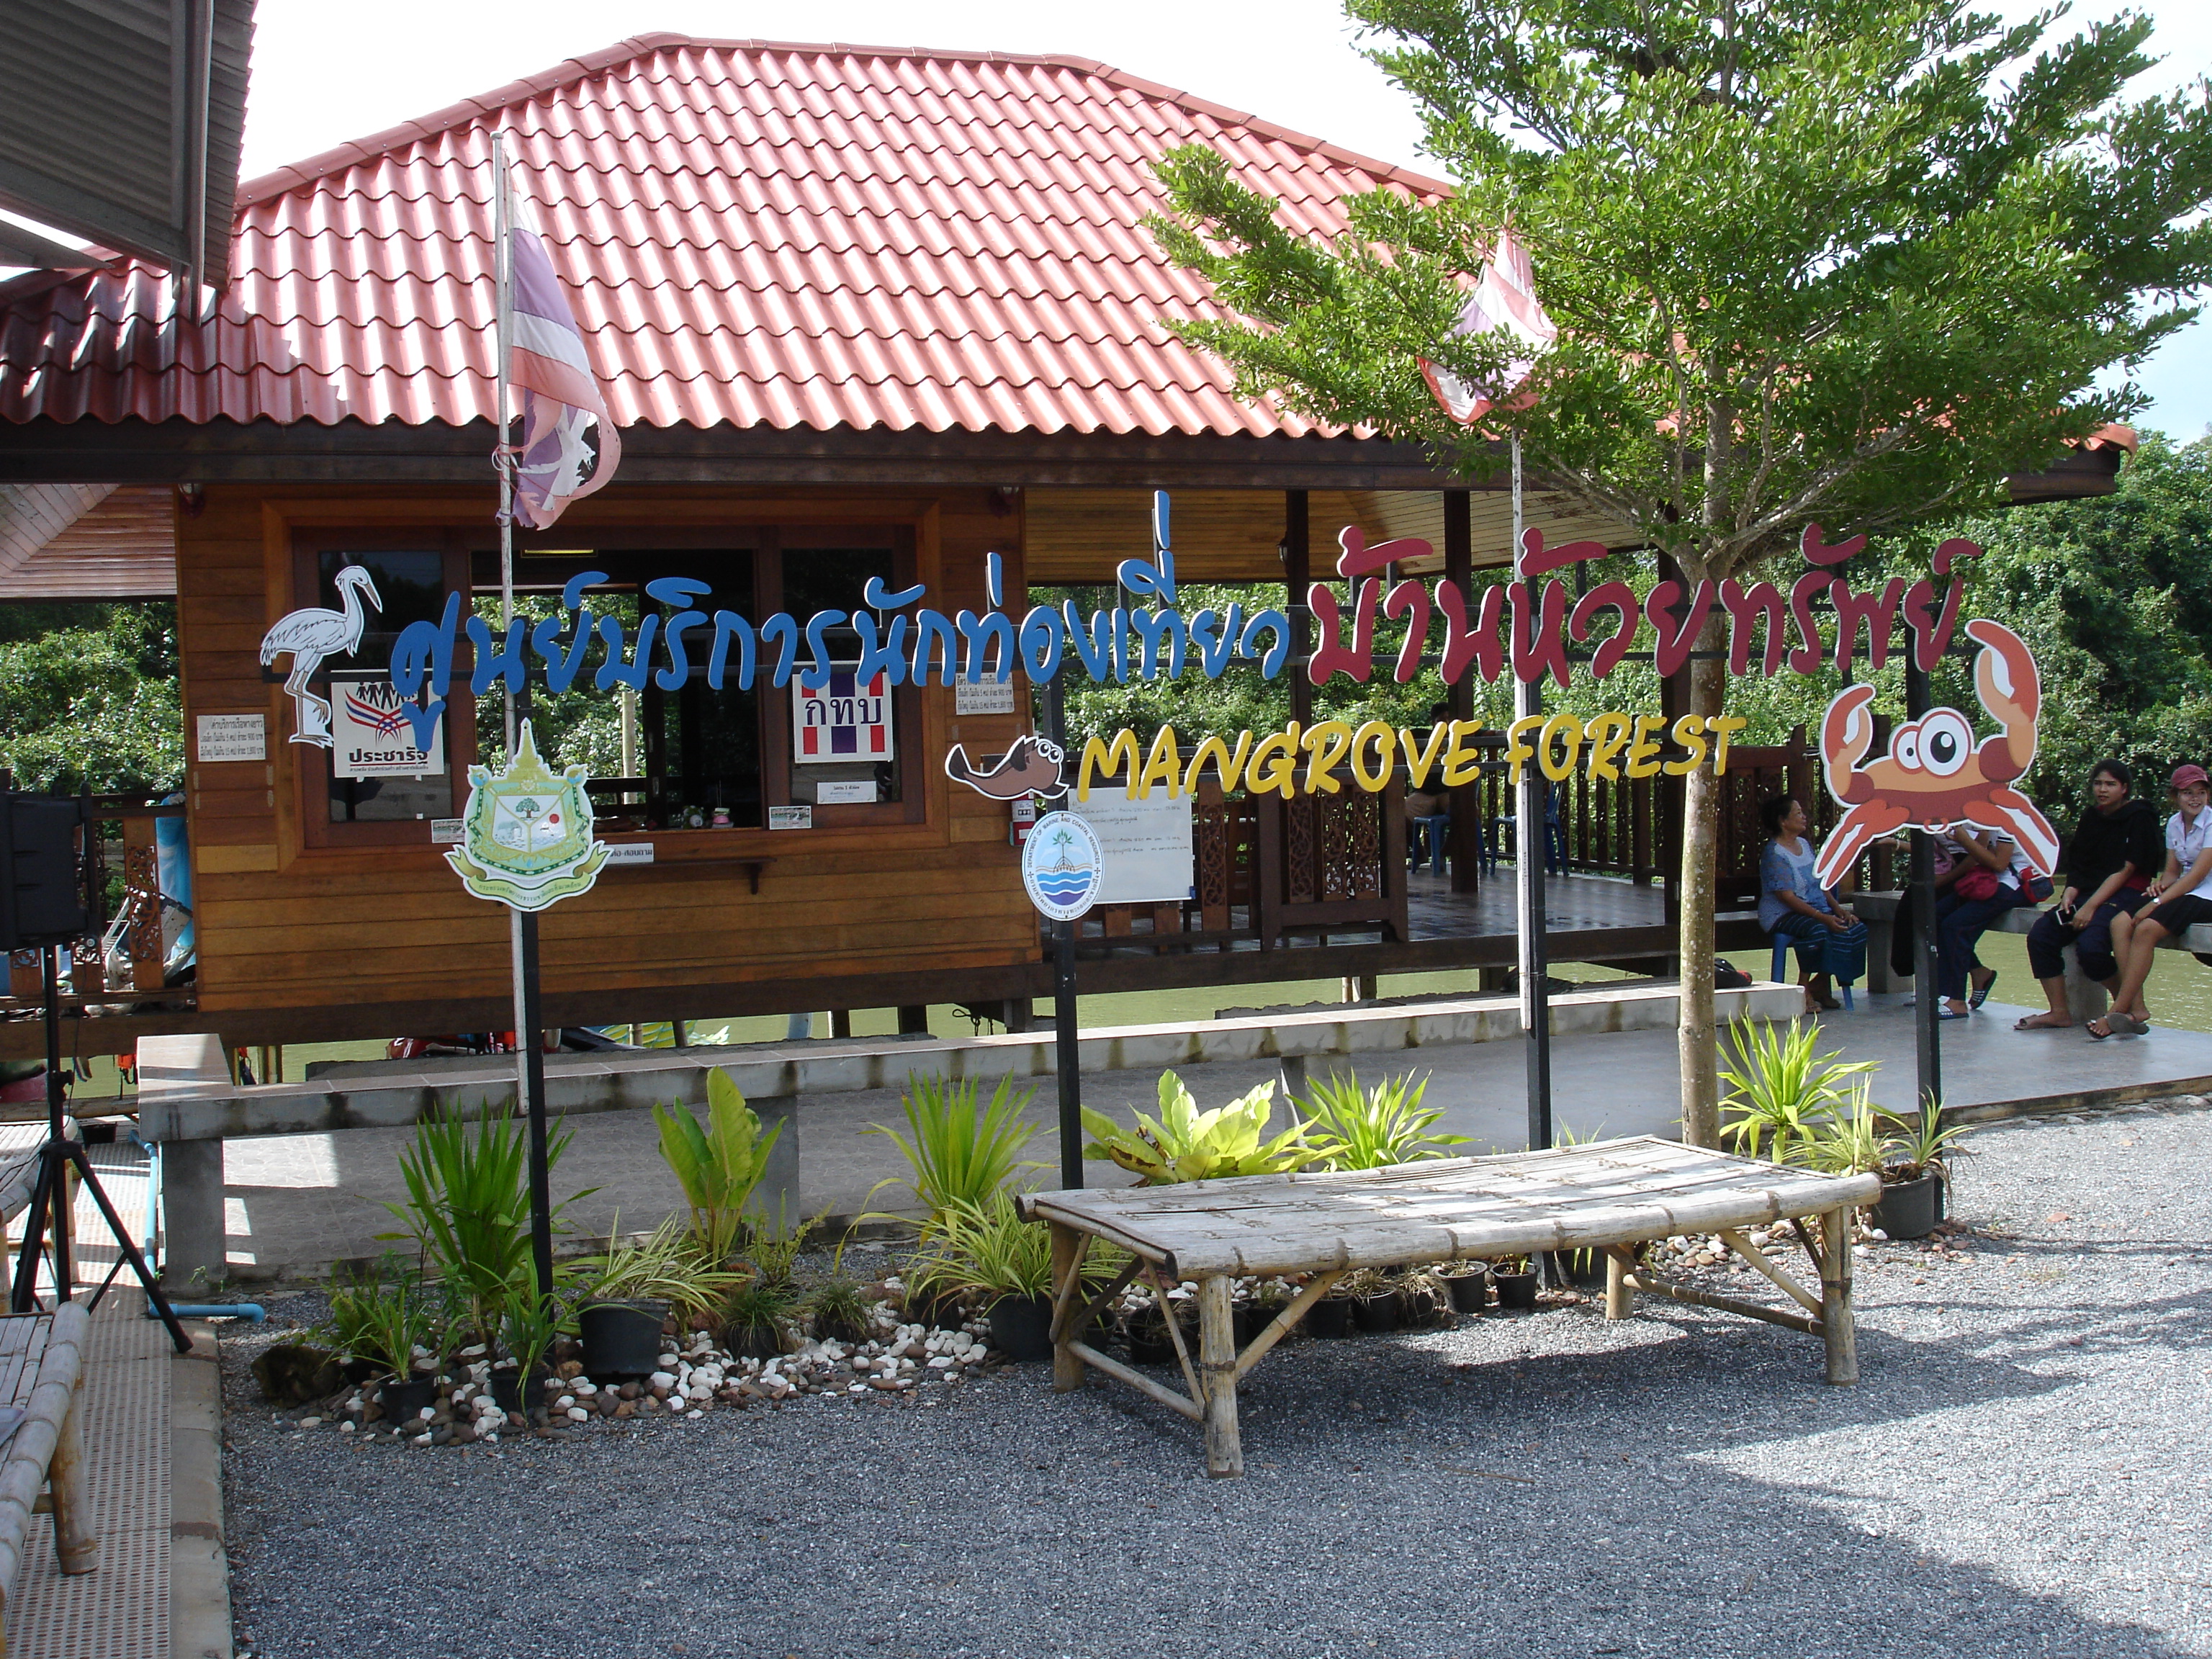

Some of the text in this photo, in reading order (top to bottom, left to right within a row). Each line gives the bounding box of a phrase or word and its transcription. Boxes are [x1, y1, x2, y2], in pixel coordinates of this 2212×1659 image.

[389, 489, 1982, 753] ศูนย์บริการนักท่องเที่ยว บ้านห้วยทรัพย์
[805, 698, 884, 726] กทบ
[1077, 711, 1748, 803] MANGROVE FOREST
[1027, 834, 1039, 868] DEPARTMENT
[1042, 817, 1059, 829] MARINE
[1071, 819, 1089, 836] COASTAL
